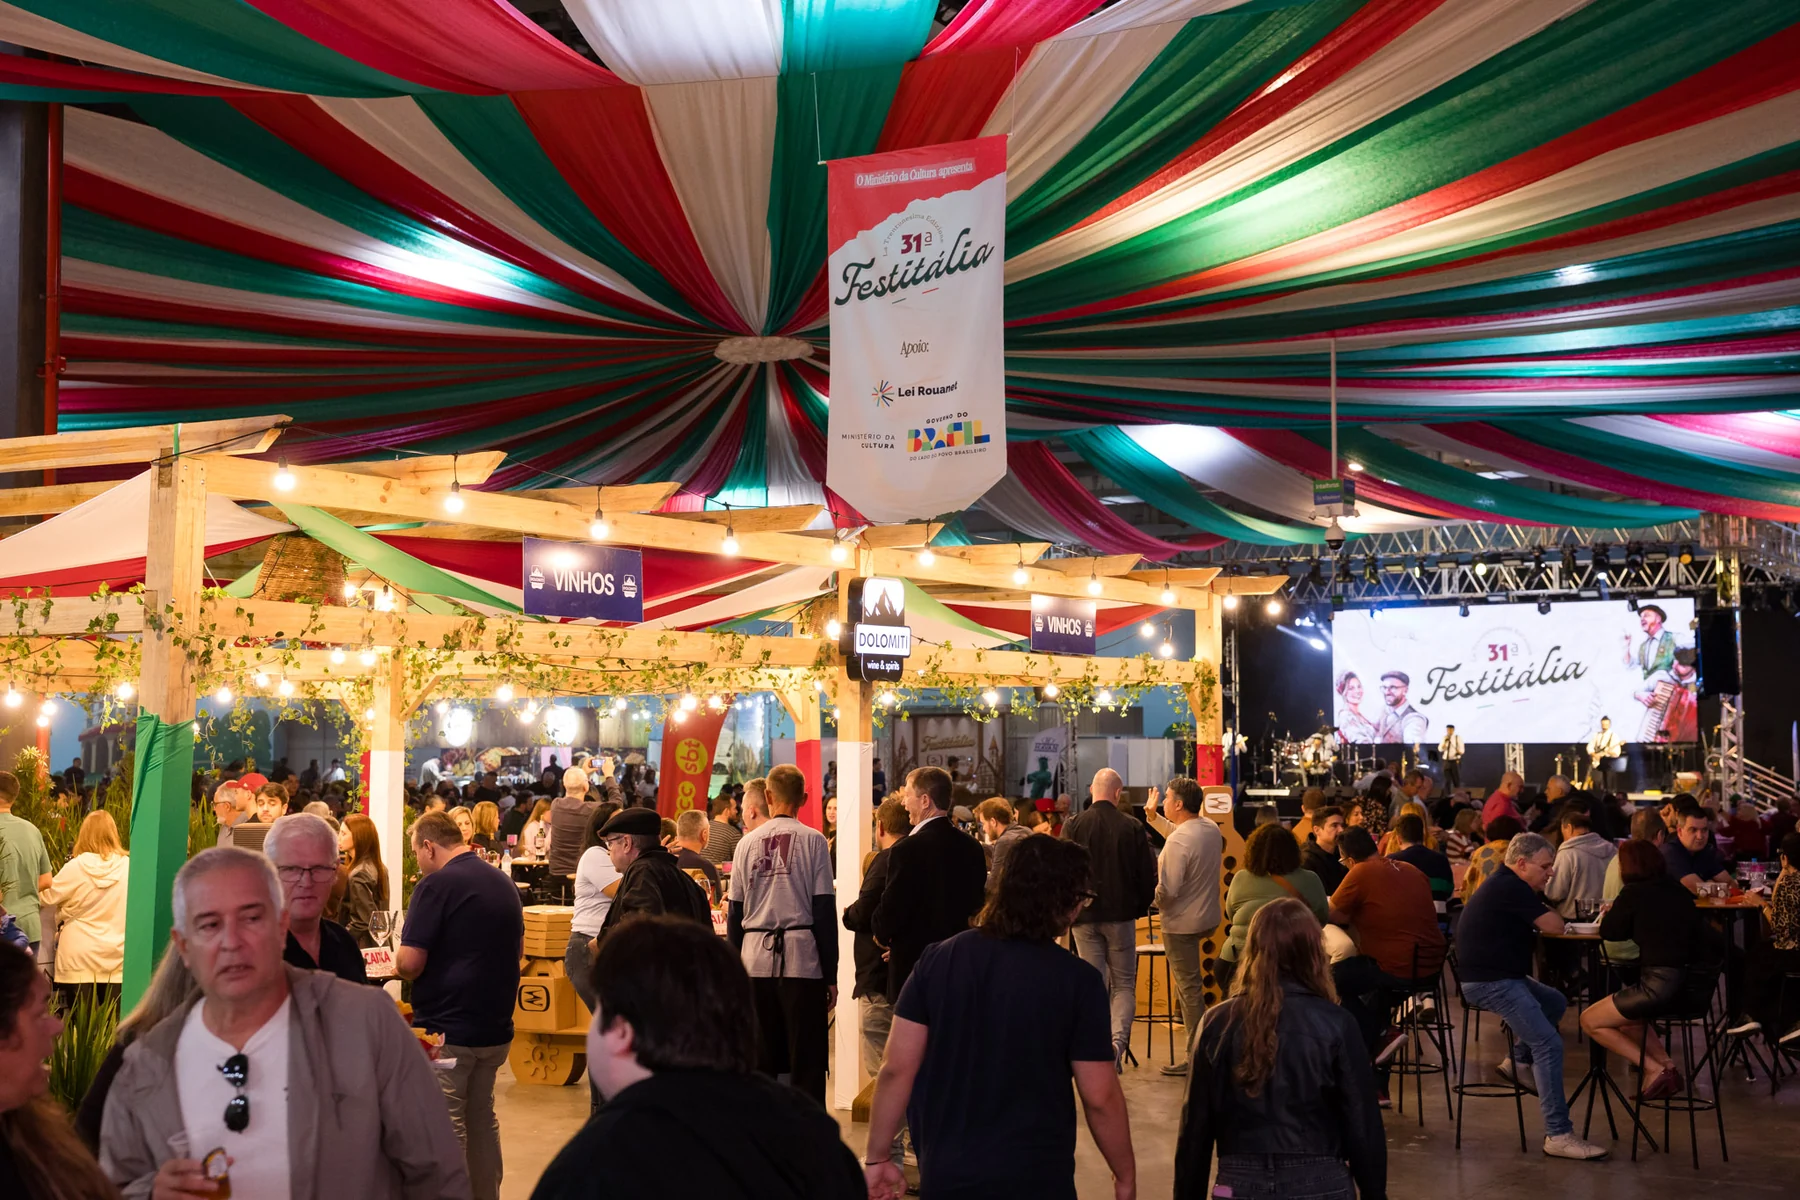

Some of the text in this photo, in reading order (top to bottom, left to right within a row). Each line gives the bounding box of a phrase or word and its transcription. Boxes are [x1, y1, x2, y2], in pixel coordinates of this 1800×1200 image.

[856, 162, 973, 186] O Ministério da Cultura apresenta
[834, 227, 995, 306] Festitália
[900, 339, 929, 358] Apoio:
[898, 381, 958, 397] Lei Rouanet
[926, 413, 954, 424] GOVERNO
[907, 419, 990, 453] BRASIL
[861, 442, 895, 450] CULTURA
[955, 447, 987, 455] BRASILEIRO
[553, 567, 615, 596] VINHOS
[1048, 615, 1082, 636] VINHOS
[859, 632, 908, 650] DOLOMITI
[867, 660, 900, 673] wine & spirits
[1420, 646, 1588, 706] Festitália
[680, 740, 700, 773] sbt
[364, 950, 391, 965] CAIXA
